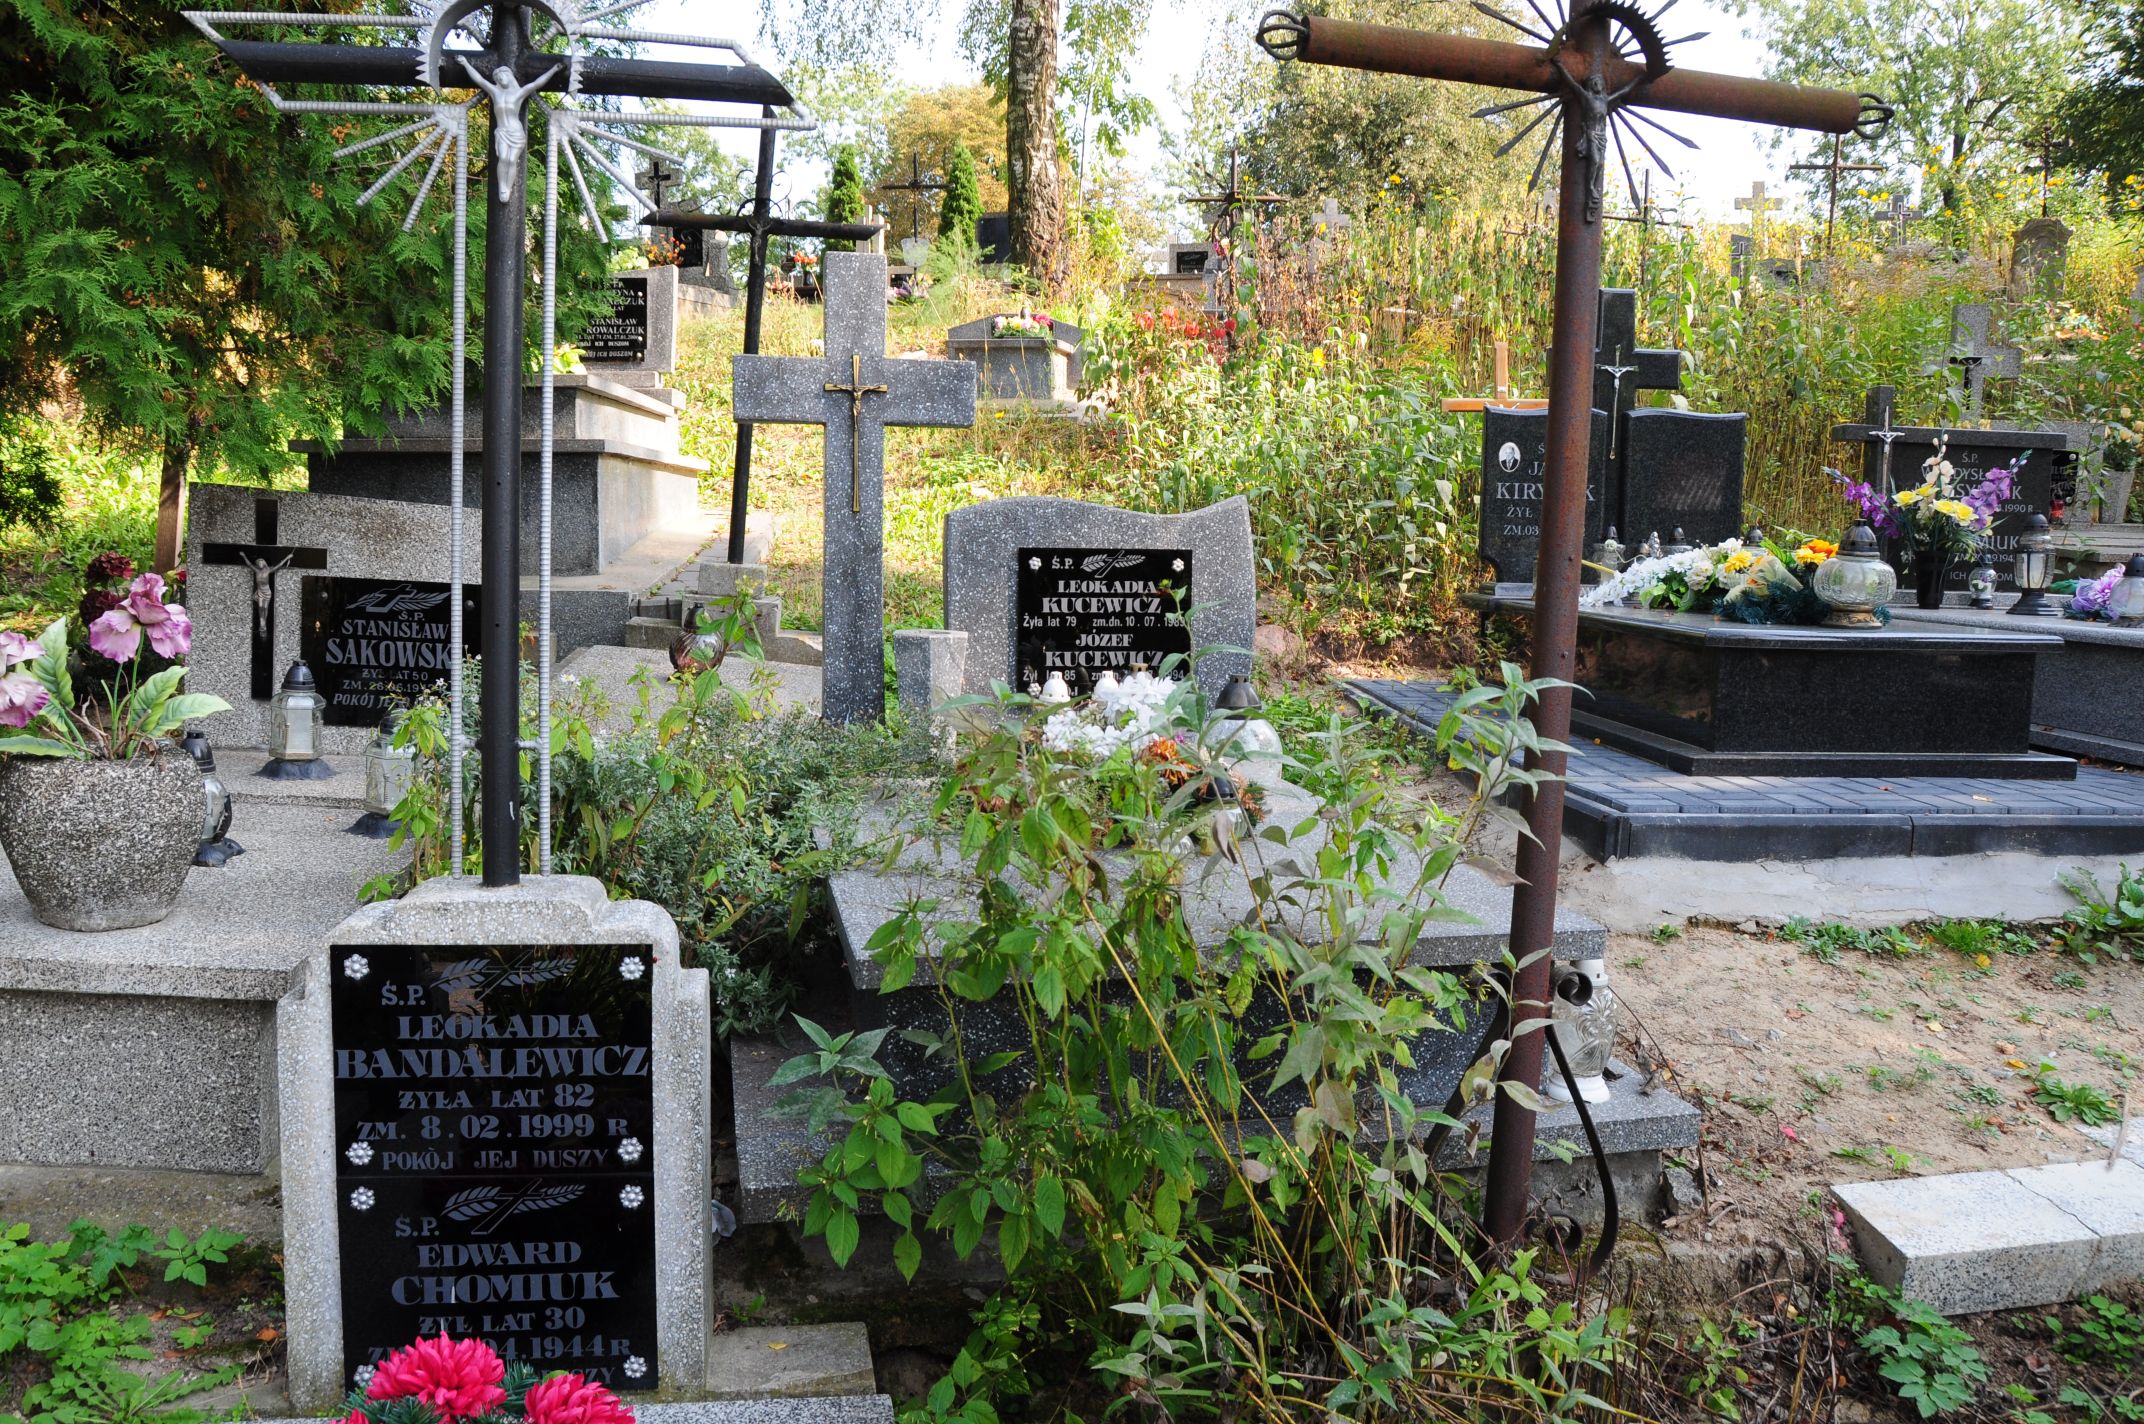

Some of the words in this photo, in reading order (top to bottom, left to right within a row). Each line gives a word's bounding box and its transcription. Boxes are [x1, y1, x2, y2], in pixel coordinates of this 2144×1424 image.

[1052, 555, 1075, 570] Ś.P.
[1058, 580, 1157, 594] LEOKADIA
[1042, 597, 1162, 614] KUCEWICZ
[341, 619, 450, 640] STANISŁAW
[1023, 613, 1043, 630] Żyła
[1047, 616, 1060, 627] lat
[1066, 616, 1077, 627] 79
[1075, 629, 1134, 647] JÓZEF
[325, 638, 452, 670] SAKOWSK
[1044, 651, 1163, 668] KUCEWICZ
[412, 671, 428, 681] 50
[1023, 669, 1038, 684] Żył
[1064, 670, 1076, 681] 85
[333, 692, 374, 709] POKÓJ
[381, 979, 426, 1006] Ś.P.
[397, 1013, 599, 1041] LEOKADIA
[335, 1045, 650, 1080] BANDALEWICZ
[398, 1089, 473, 1110] ŻYŁA
[491, 1087, 545, 1109] LAT
[554, 1083, 595, 1108] 82
[607, 1117, 629, 1137] R
[473, 1150, 518, 1170] JEJ
[533, 1149, 609, 1169] DUSZY
[417, 1240, 582, 1268] EDWARD
[391, 1271, 622, 1306] CHOMIUK
[482, 1311, 536, 1333] LAT
[544, 1306, 586, 1331] 30
[610, 1338, 631, 1356] R
